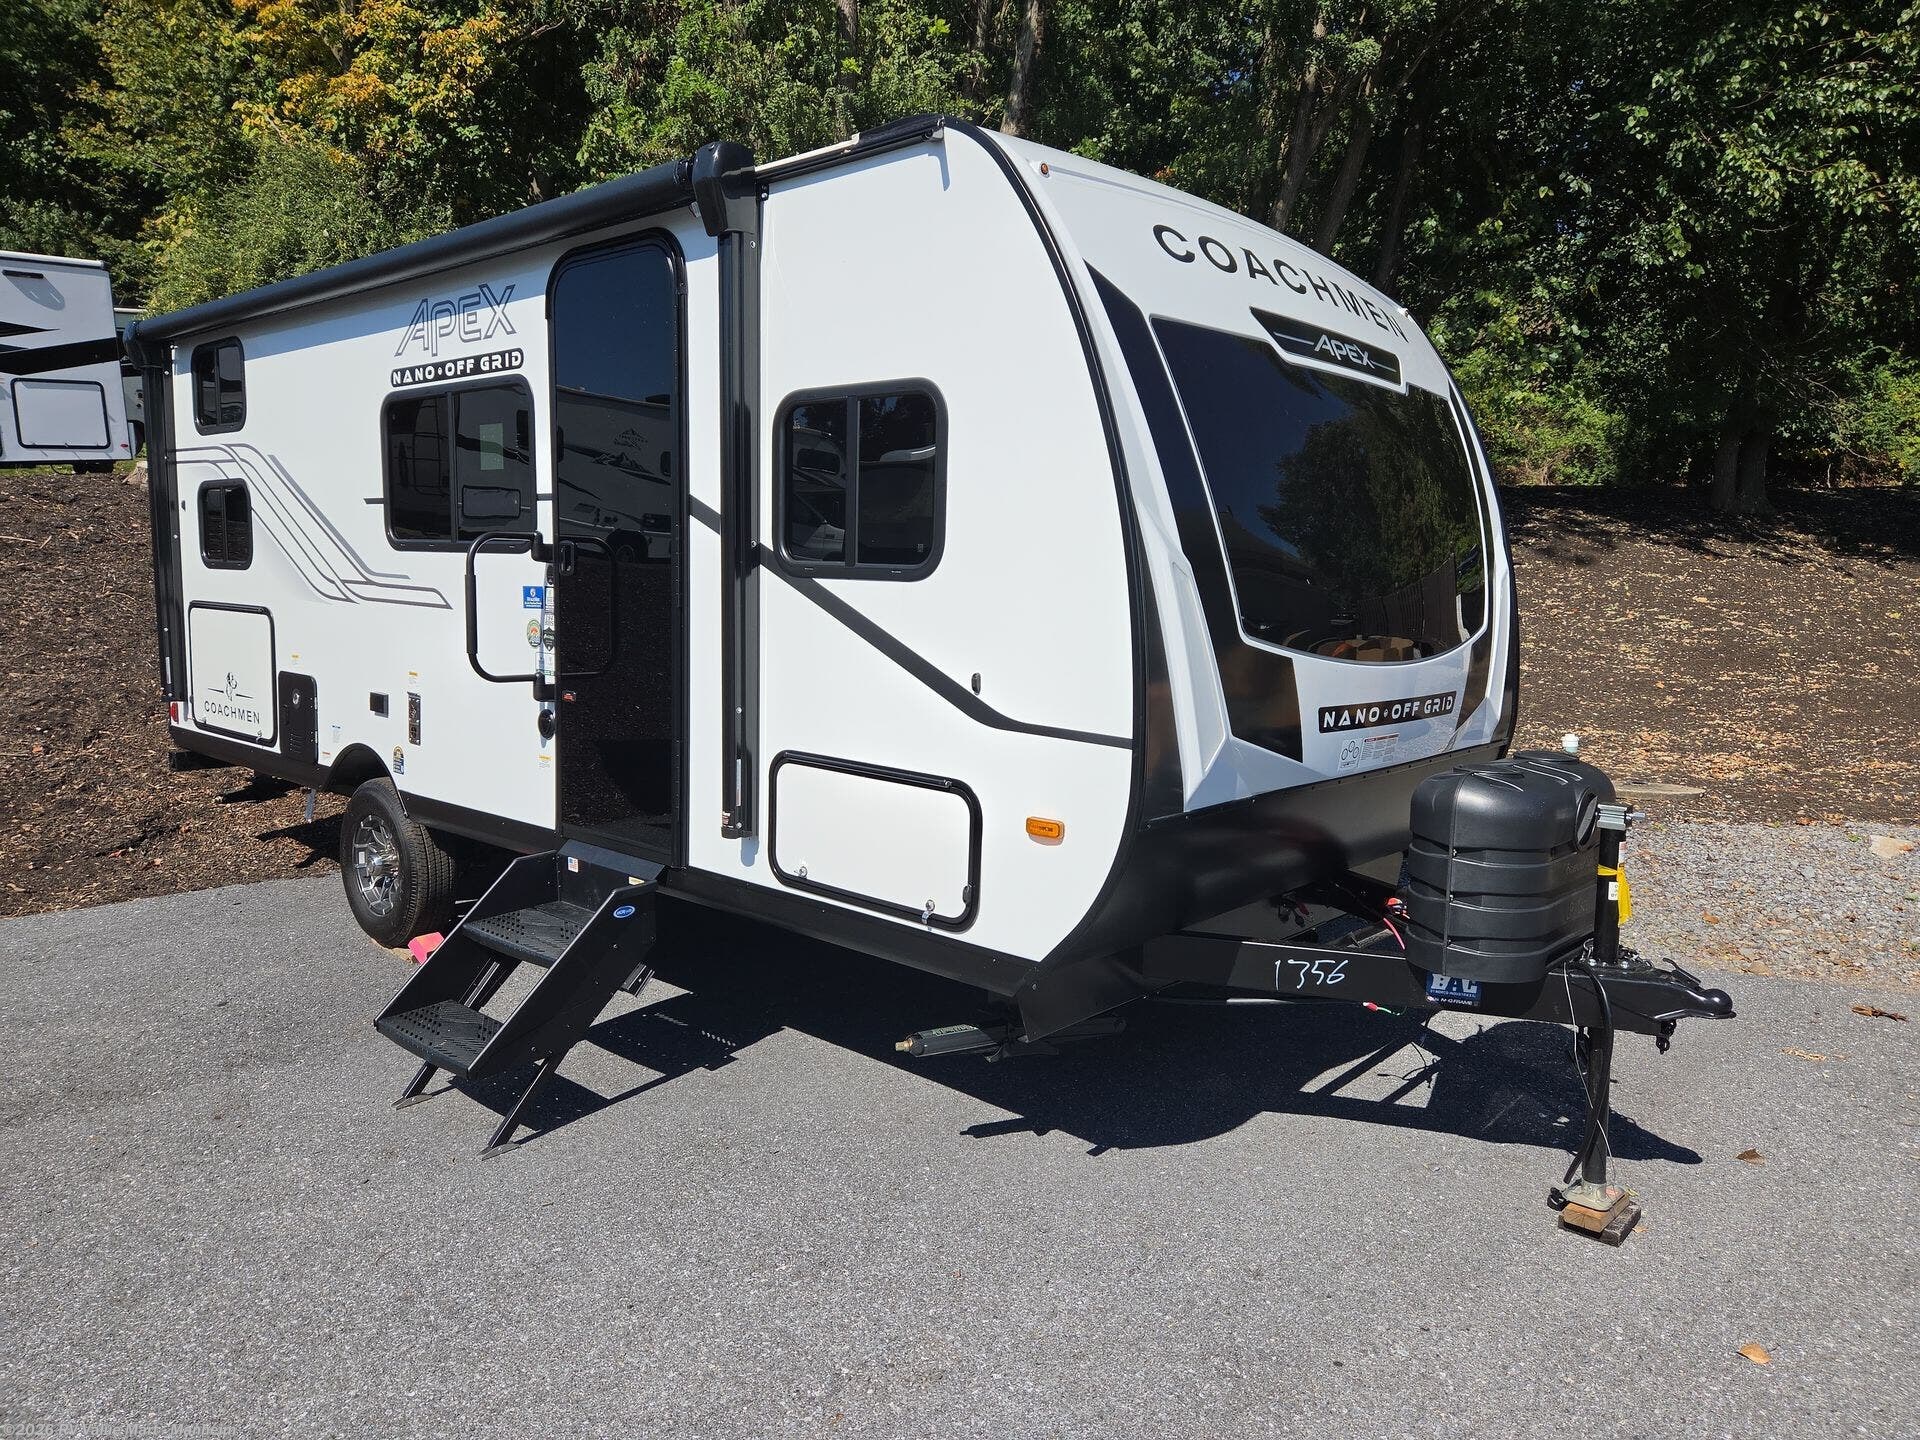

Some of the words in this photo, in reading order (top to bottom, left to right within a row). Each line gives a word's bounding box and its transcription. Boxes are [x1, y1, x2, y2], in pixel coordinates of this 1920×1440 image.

[1152, 224, 1410, 344] COACHMEN
[393, 283, 517, 357] APEX
[480, 350, 522, 371] GRID
[1313, 334, 1375, 370] APEX
[204, 700, 260, 724] COACHMEN
[1424, 695, 1453, 714] GRID
[1275, 959, 1349, 991] 1356
